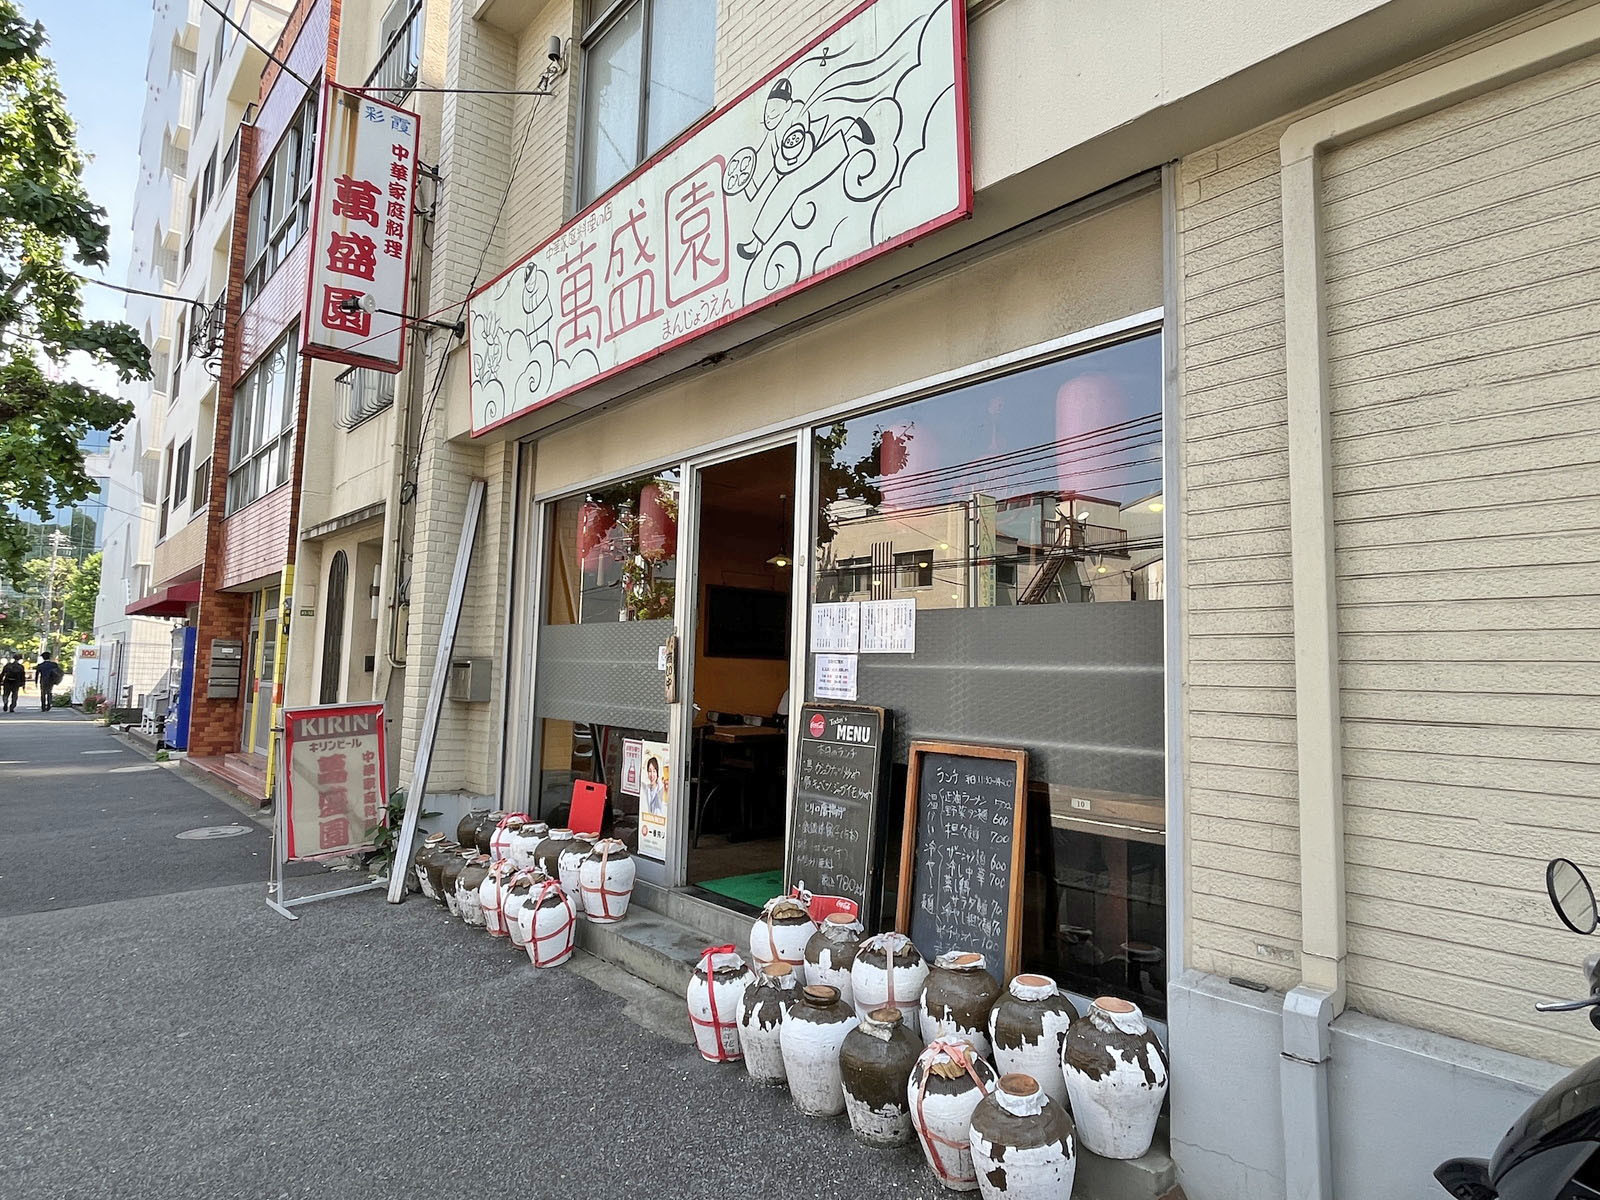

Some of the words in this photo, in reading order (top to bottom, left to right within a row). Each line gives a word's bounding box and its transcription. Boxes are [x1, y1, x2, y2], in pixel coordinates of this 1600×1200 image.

[384, 144, 410, 259] 中華家庭料理
[555, 154, 730, 359] 萬盛園
[662, 288, 735, 340] まんじょうえん
[301, 714, 369, 737] KIRIN
[836, 724, 871, 743] MENU
[309, 739, 362, 752] キリンビール
[937, 767, 958, 784] ランチ
[1077, 800, 1086, 808] 10
[992, 813, 1009, 827] 600
[990, 831, 1010, 844] 700
[990, 853, 1007, 872] 600
[989, 872, 1006, 888] 700
